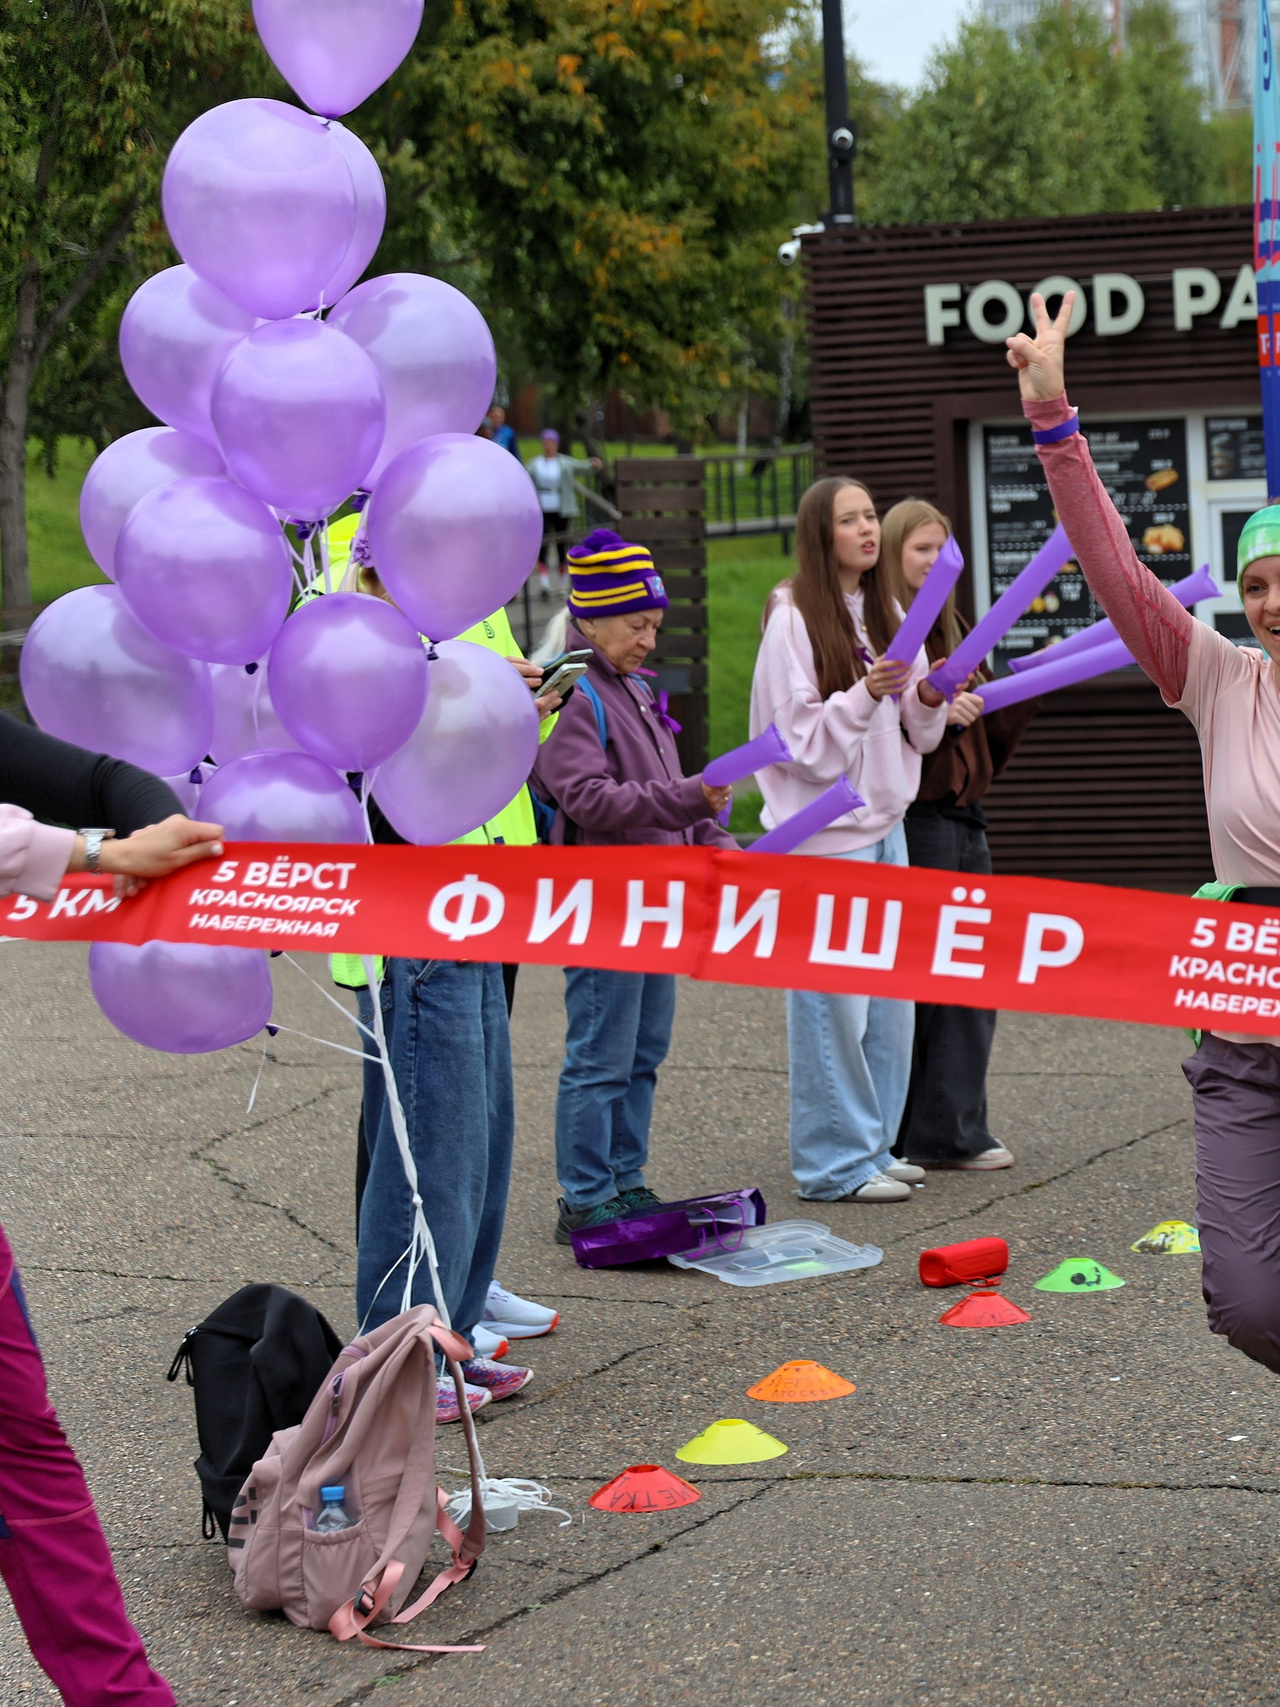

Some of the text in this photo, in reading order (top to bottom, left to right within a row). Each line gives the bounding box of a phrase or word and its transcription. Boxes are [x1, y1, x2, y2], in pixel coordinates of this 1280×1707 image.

[924, 272, 1146, 347] FOOD
[211, 856, 357, 890] 5 ВЁРСТ
[7, 888, 123, 921] 5 КМ
[188, 888, 361, 916] КРАСНОЯРСК
[189, 914, 340, 937] НАБЕРЕЖНАЯ
[427, 873, 1085, 984] ФИНИШЁР
[1189, 917, 1217, 948] 5
